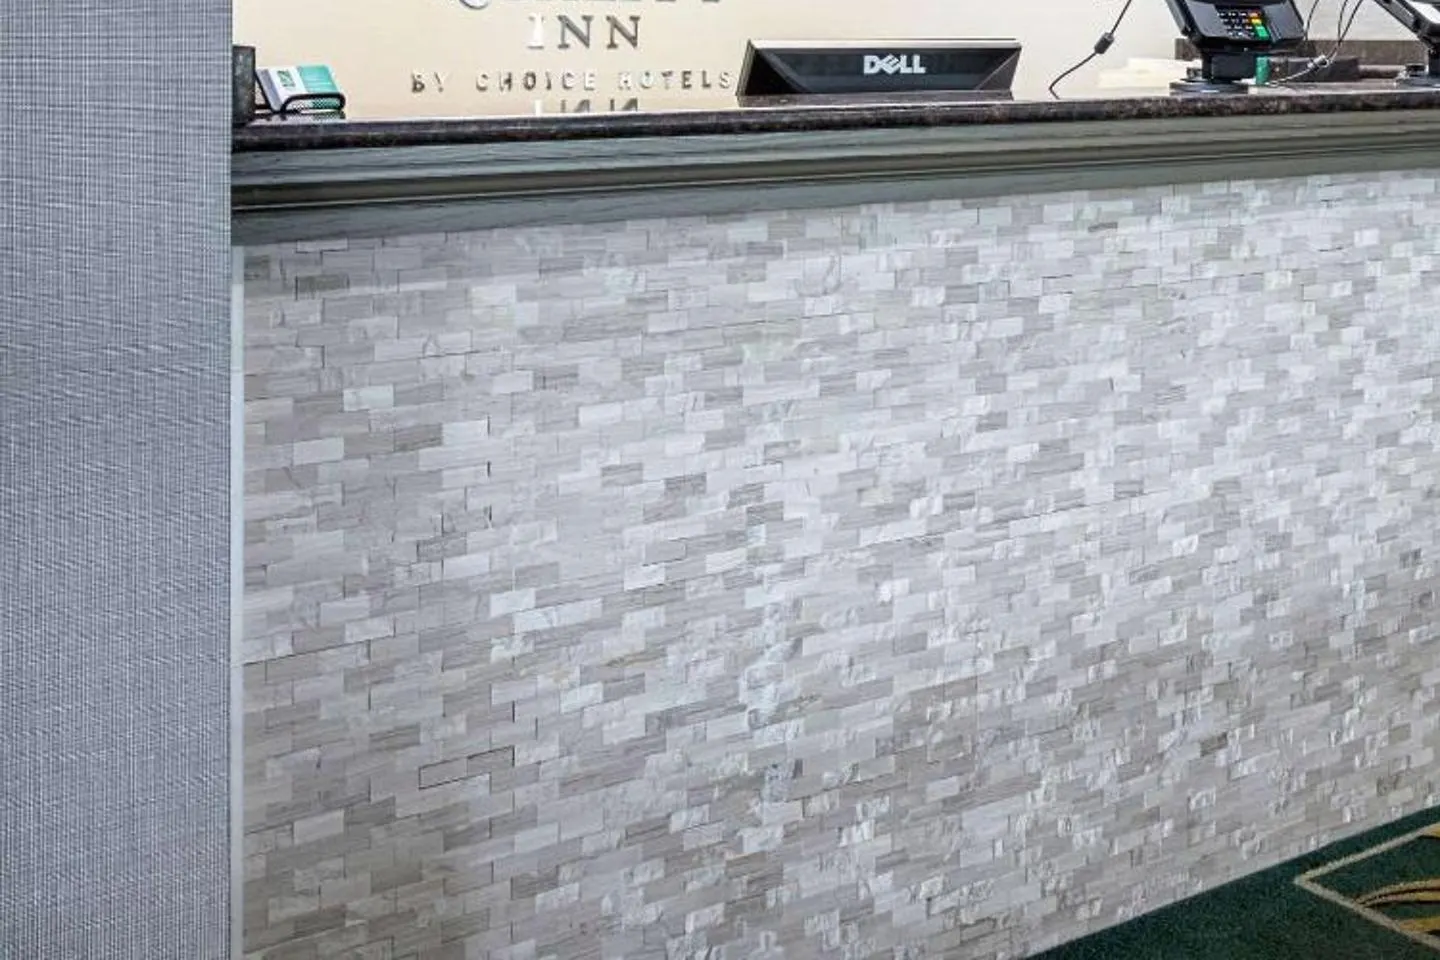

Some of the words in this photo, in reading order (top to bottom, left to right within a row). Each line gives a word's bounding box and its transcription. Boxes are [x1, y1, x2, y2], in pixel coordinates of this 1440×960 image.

[526, 13, 641, 49] INN
[863, 53, 926, 75] DELL
[411, 71, 452, 93] BY
[475, 70, 596, 92] CHOICE
[618, 69, 736, 91] HOTELS
